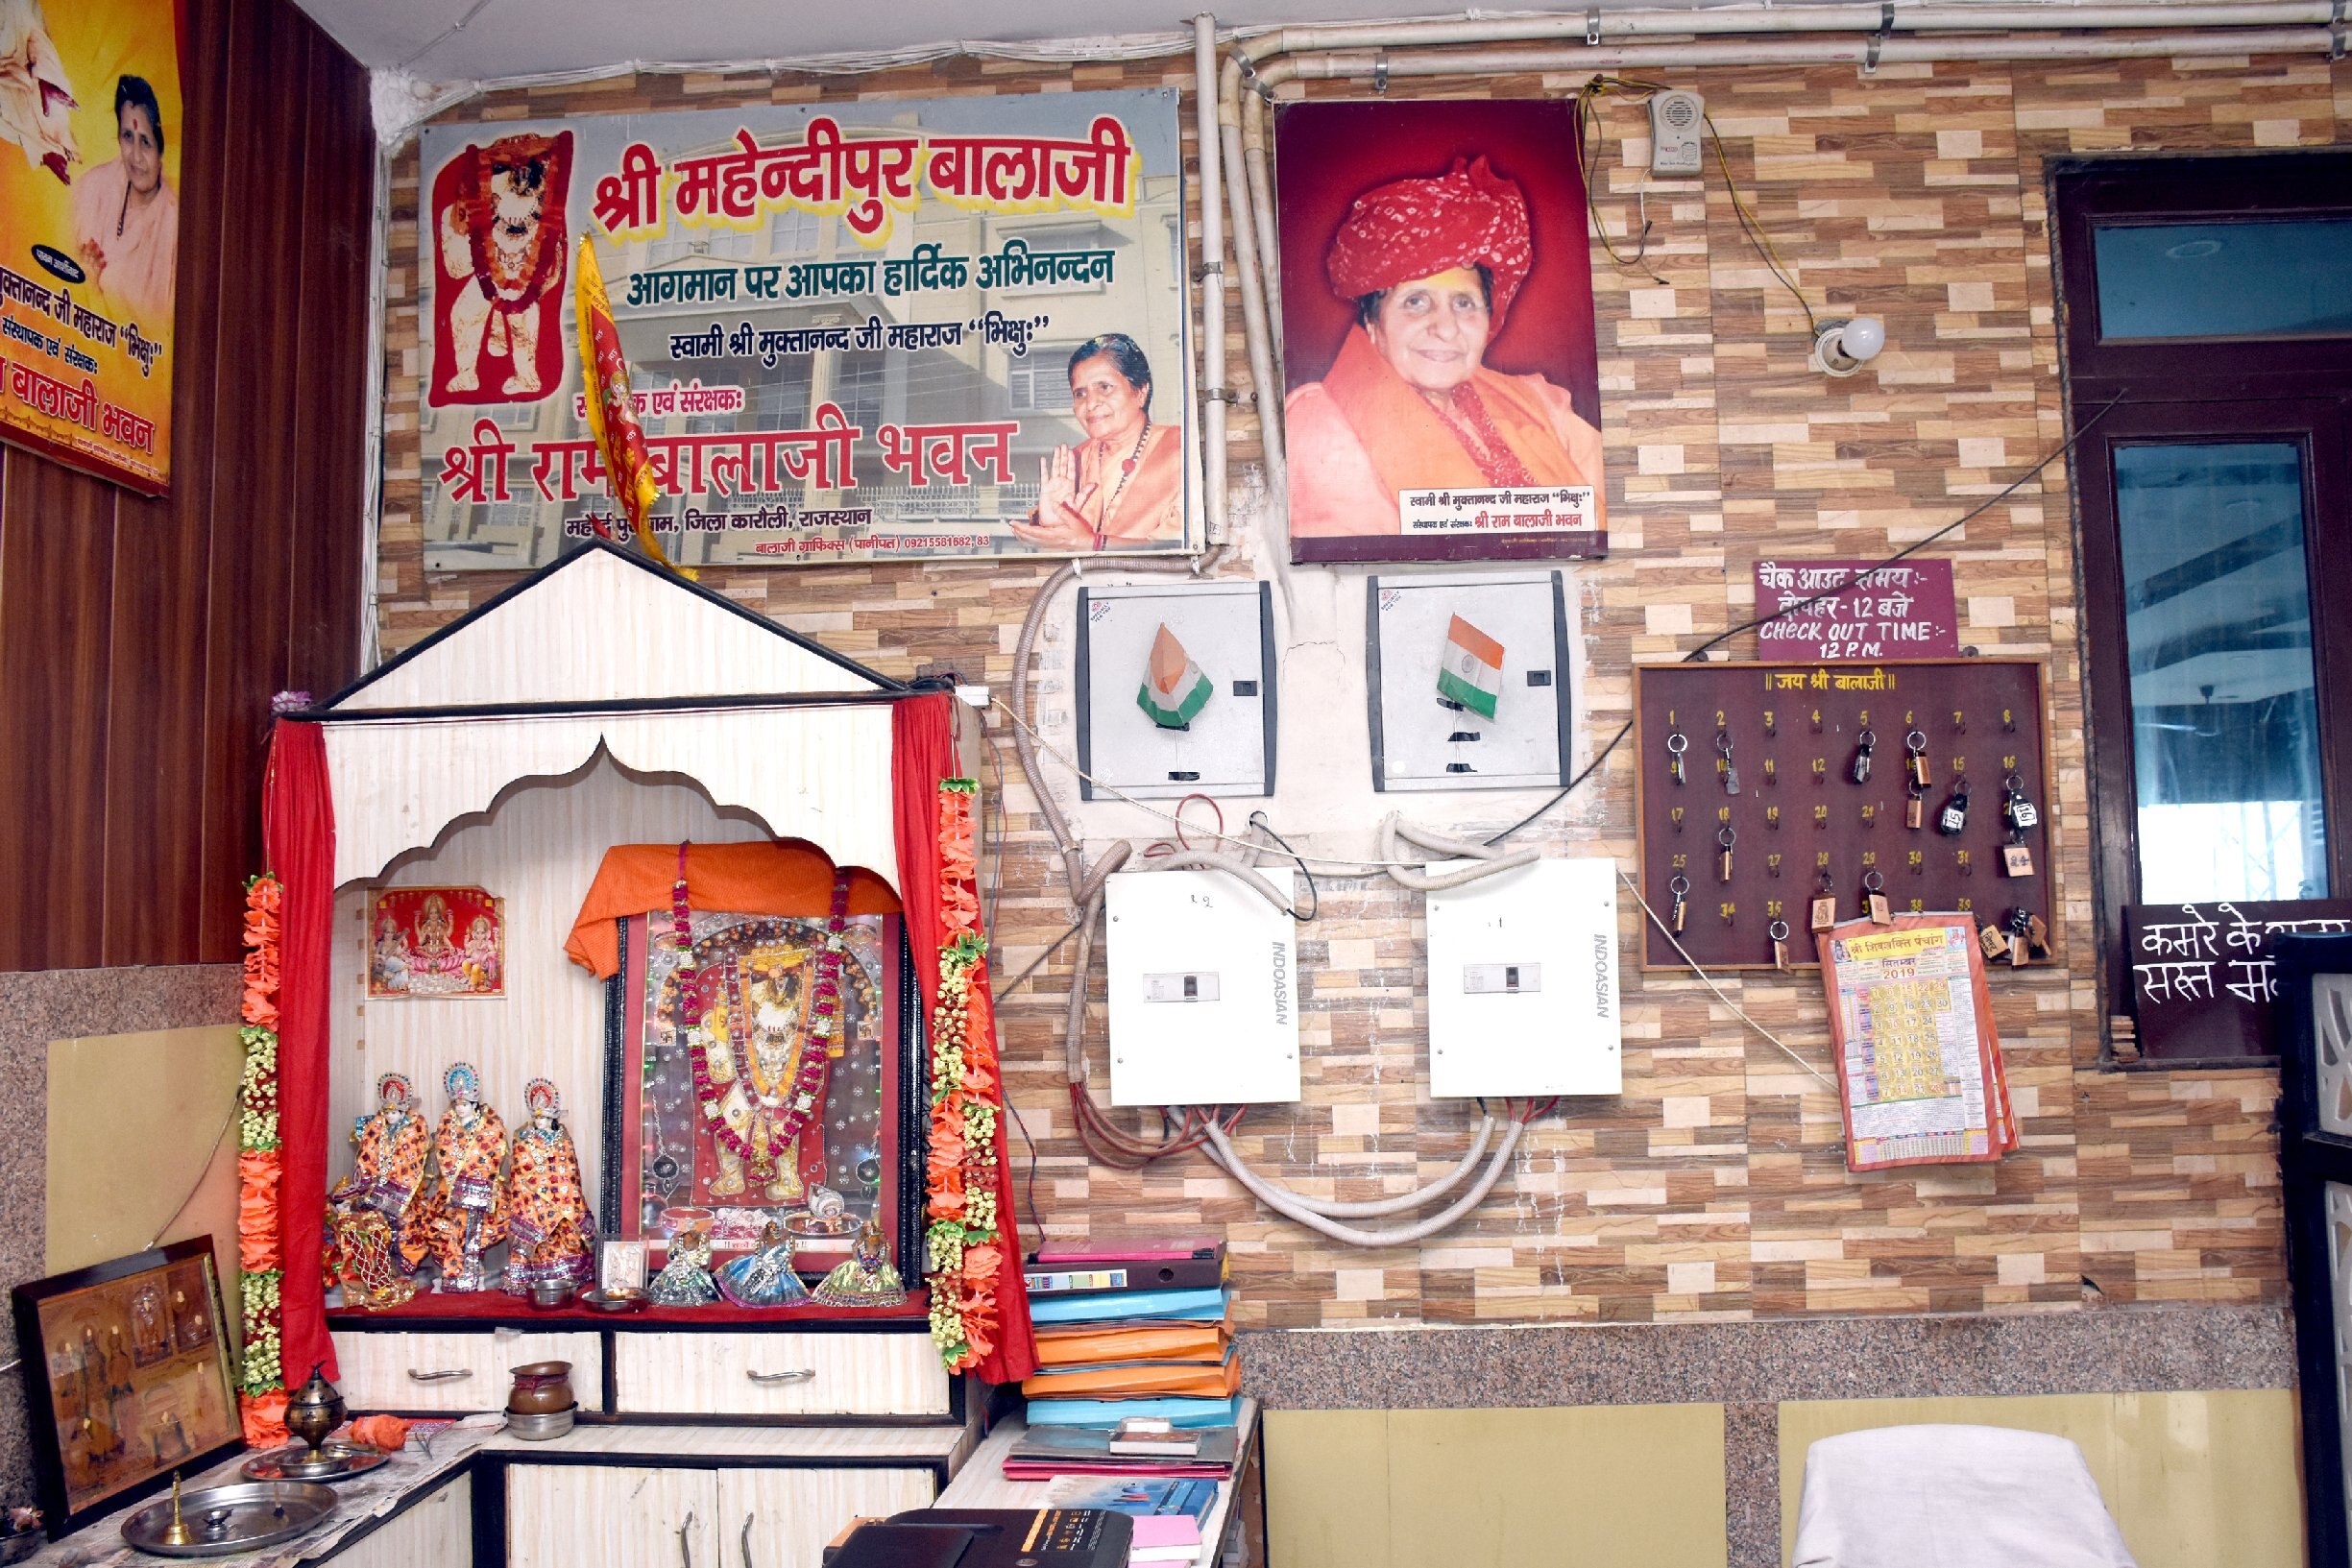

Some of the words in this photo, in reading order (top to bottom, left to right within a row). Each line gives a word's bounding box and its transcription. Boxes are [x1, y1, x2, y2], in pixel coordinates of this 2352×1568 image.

[594, 144, 661, 232] श्री
[674, 117, 918, 233] महेन्दीपुर
[928, 116, 1130, 204] बालाजी
[626, 268, 738, 306] आगमान
[744, 266, 781, 297] पर
[785, 260, 876, 298] आपका
[883, 243, 969, 296] हार्दिक
[976, 240, 1115, 289] अभिनन्दन
[54, 289, 71, 326] जी
[73, 304, 116, 349] महाराज
[3, 315, 44, 350] संस्थापक
[46, 336, 61, 358] एवं
[669, 325, 723, 358] स्वामी
[729, 323, 753, 355] श्री
[759, 326, 850, 365] मुक्तानन्द
[855, 317, 882, 350] जी
[887, 322, 961, 350] महाराज
[12, 361, 97, 430] बालाजी
[103, 403, 155, 454] भवन
[652, 383, 679, 415] एवं
[440, 419, 516, 503] श्री
[647, 403, 861, 495] बालाजी
[878, 422, 1018, 487] भवन
[1410, 493, 1436, 507] स्वामी
[1440, 491, 1451, 506] श्री
[1498, 491, 1513, 505] जी
[1514, 493, 1549, 504] महाराज
[686, 508, 728, 531] जिला
[800, 508, 871, 527] राजस्थान
[1474, 510, 1489, 529] श्री
[1491, 514, 1511, 528] राम
[1513, 509, 1552, 528] बालाजी
[1555, 514, 1582, 527] भवन
[756, 538, 795, 554] बालाजी
[848, 534, 900, 554] (पानीपत)
[977, 536, 990, 546] 83
[1853, 596, 1874, 618] 12
[1828, 622, 1867, 641] OUT
[1876, 621, 1932, 641] TIME
[1819, 642, 1841, 660] 12
[1669, 710, 1675, 726] 1
[1716, 710, 1726, 726] 2
[1763, 711, 1774, 726] 3
[1811, 709, 1821, 723] 4
[1859, 710, 1868, 725] 5
[1905, 710, 1913, 724] 6
[1953, 712, 1962, 723] 7
[2003, 709, 2011, 723] 8
[1812, 758, 1826, 772] 12
[1953, 757, 1966, 771] 15
[2002, 755, 2016, 769] 16
[1671, 807, 1685, 821] 17
[1673, 854, 1686, 867] 25
[2142, 904, 2219, 958] कमरे
[2218, 903, 2262, 954] के
[1273, 941, 1287, 1025] INDOASIAN
[1594, 933, 1609, 1018] INDOASIAN
[1883, 968, 1915, 979] 2019
